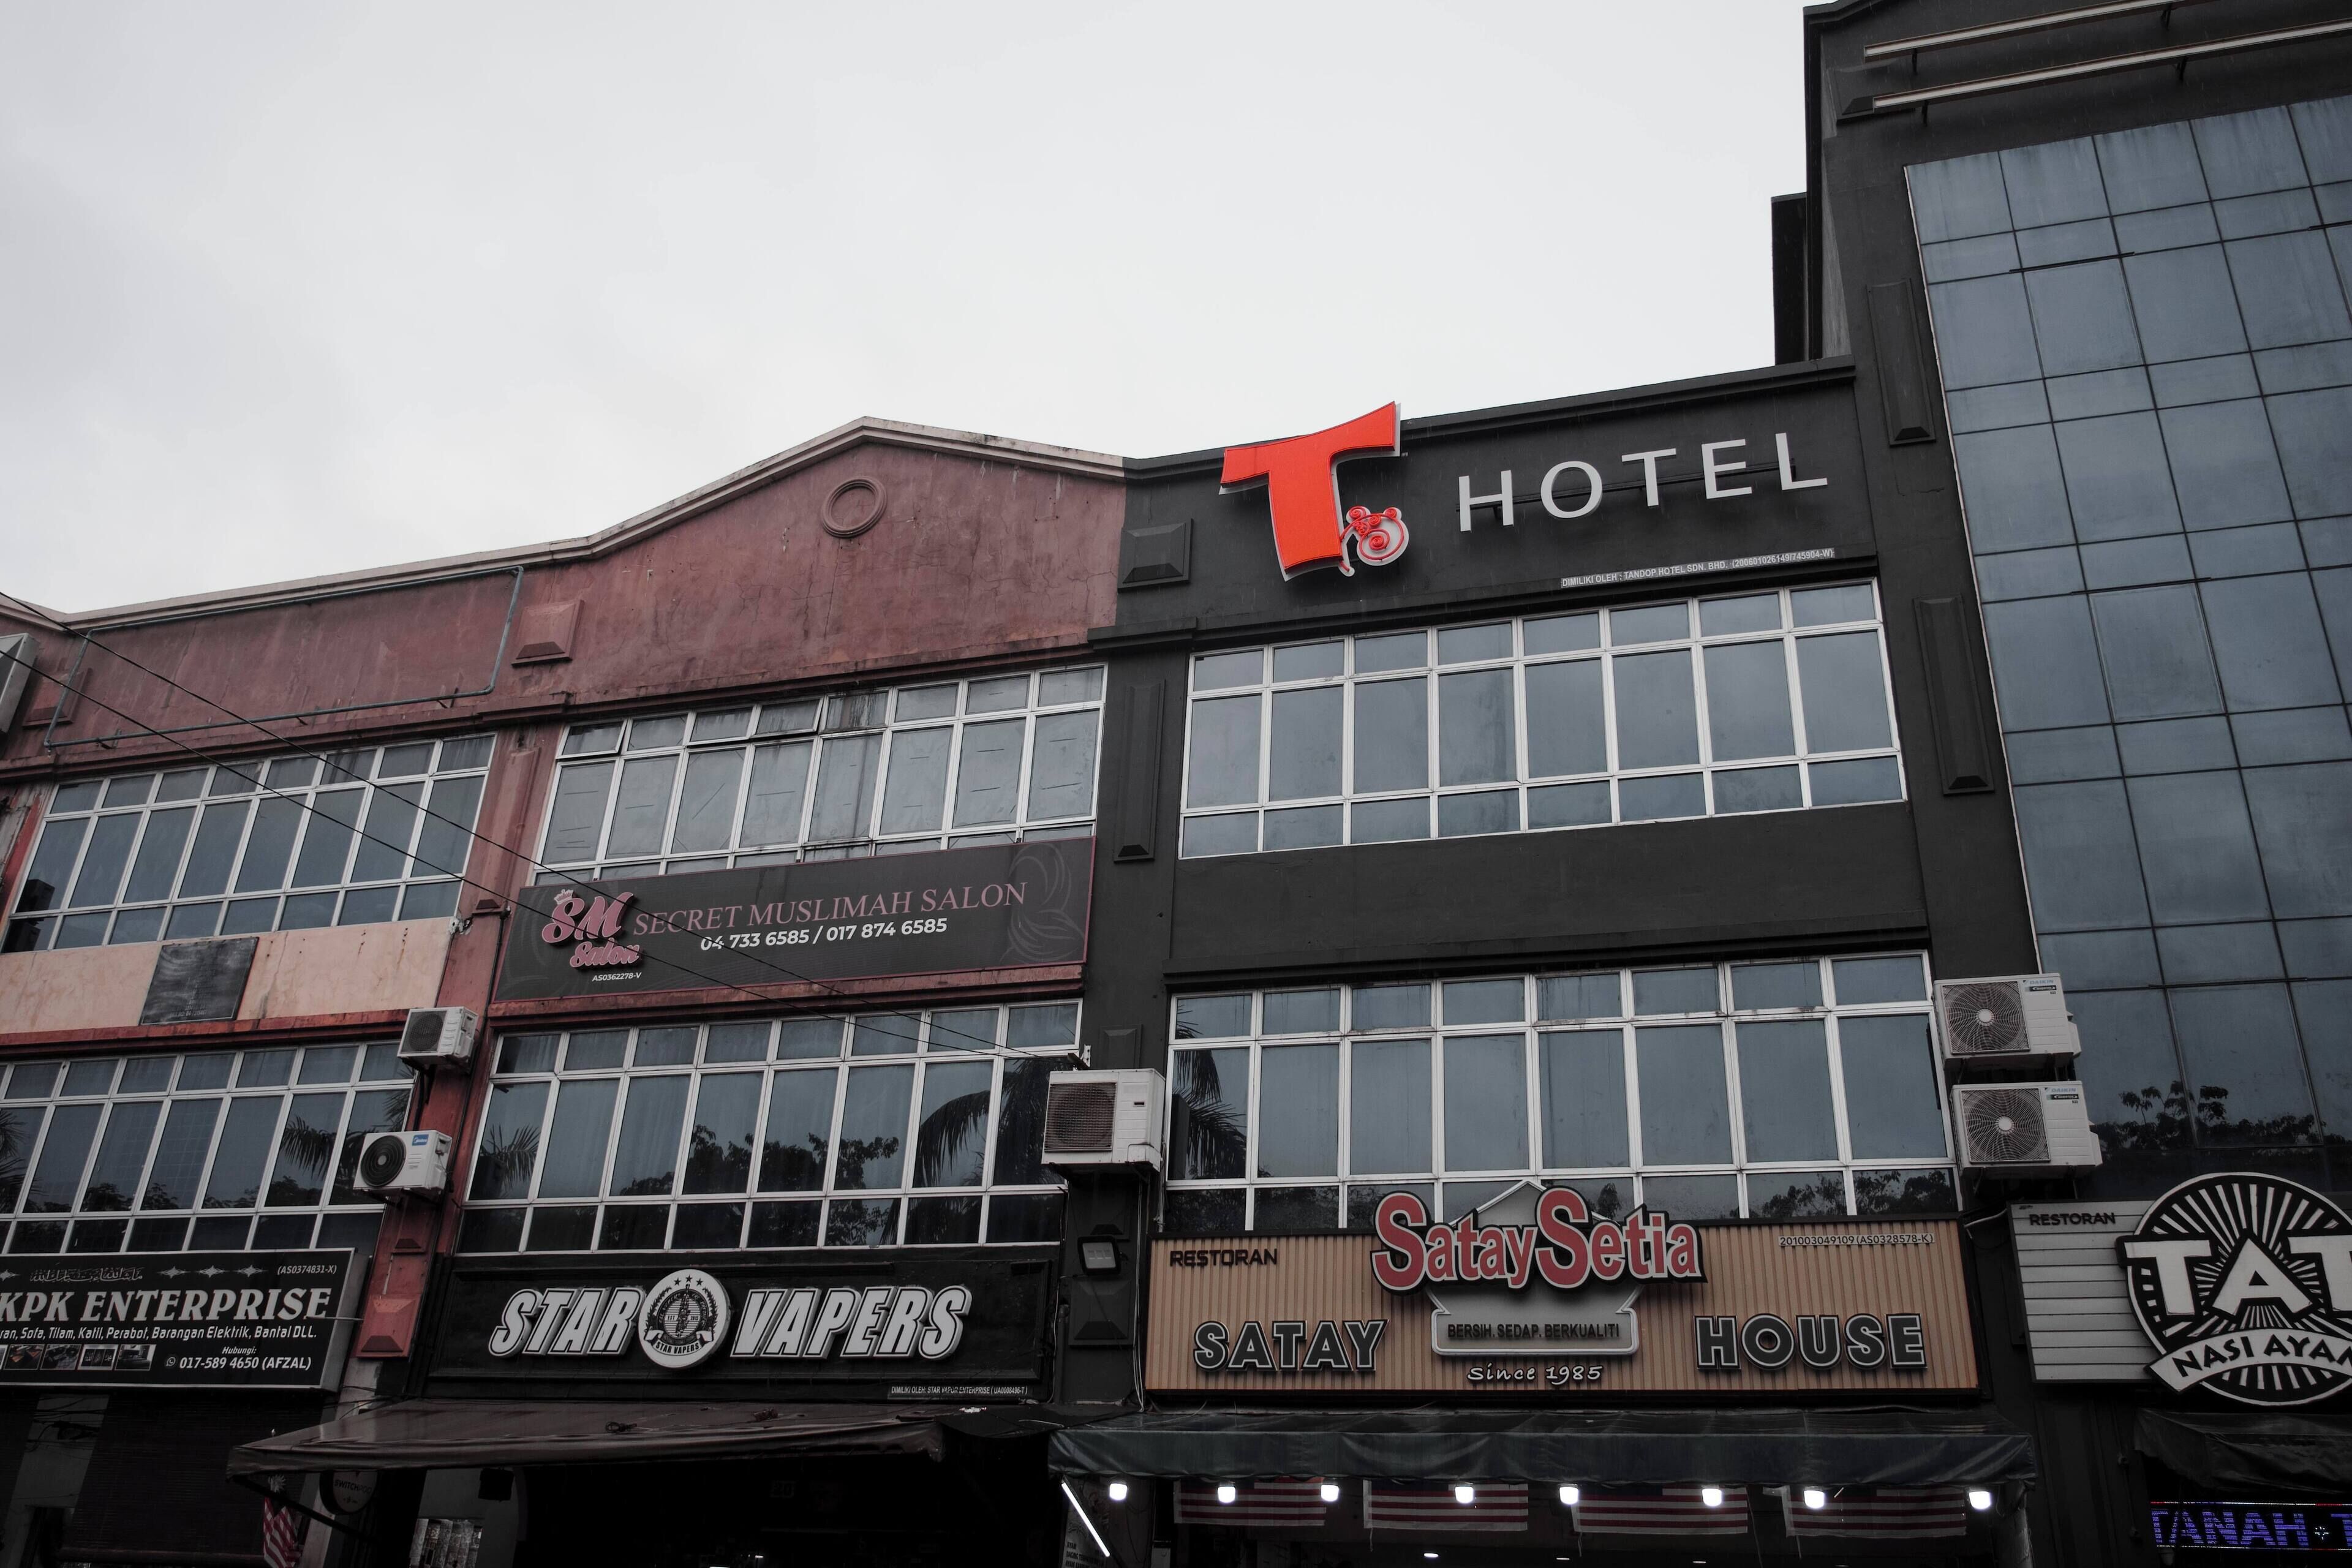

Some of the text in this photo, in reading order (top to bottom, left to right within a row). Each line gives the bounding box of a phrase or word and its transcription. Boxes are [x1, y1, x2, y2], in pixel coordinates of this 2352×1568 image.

[1458, 433, 1828, 532] HOTEL
[1562, 577, 1594, 587] DIMILIKI
[1595, 573, 1617, 583] OLEH
[1624, 569, 1656, 580] TANDOP
[1658, 566, 1686, 576] HOTEL
[1687, 563, 1706, 573] SDN.
[1708, 559, 1728, 570] BHD.
[542, 891, 633, 943] SM
[633, 881, 1028, 936] SECRET MUSLIMAH SALON
[701, 935, 725, 951] 04
[729, 932, 762, 949] 733
[766, 929, 810, 946] 6585
[827, 924, 858, 941] 017
[862, 921, 896, 939] 874
[900, 917, 948, 936] 6585
[570, 938, 639, 968] Salon
[592, 972, 642, 981] AS0362278-V
[2030, 1213, 2115, 1225] RESTORAN
[1780, 1234, 1933, 1245] 201003049109 (AS0328578-K)
[277, 1265, 337, 1275] (AS0374831-X)
[1170, 1248, 1278, 1267] RESTORAN
[0, 1287, 333, 1322] KPK ENTERPRISE
[20, 1327, 45, 1340] Sofa,
[49, 1327, 76, 1340] Tilam,
[78, 1327, 104, 1340] Katil,
[106, 1327, 149, 1340] Perabot,
[151, 1327, 204, 1341] Barangan
[206, 1325, 251, 1340] Elektrik,
[255, 1325, 290, 1338] Bantal
[293, 1325, 317, 1338] DLL.
[488, 1285, 972, 1360] STAR VAPERS
[1448, 1323, 1619, 1338] BERSIH. SEDAP. BERKUALITI
[222, 1346, 257, 1355] Hubungi:
[655, 1341, 699, 1354] STAR VAPERS
[1193, 1319, 1389, 1373] SATAY
[1693, 1313, 1928, 1371] HOUSE
[2171, 1335, 2255, 1377] NASI
[179, 1357, 311, 1370] 017-589 4650 (AFZAL)
[1467, 1362, 1603, 1385] Since 1985
[2150, 1510, 2309, 1547] TANAH
